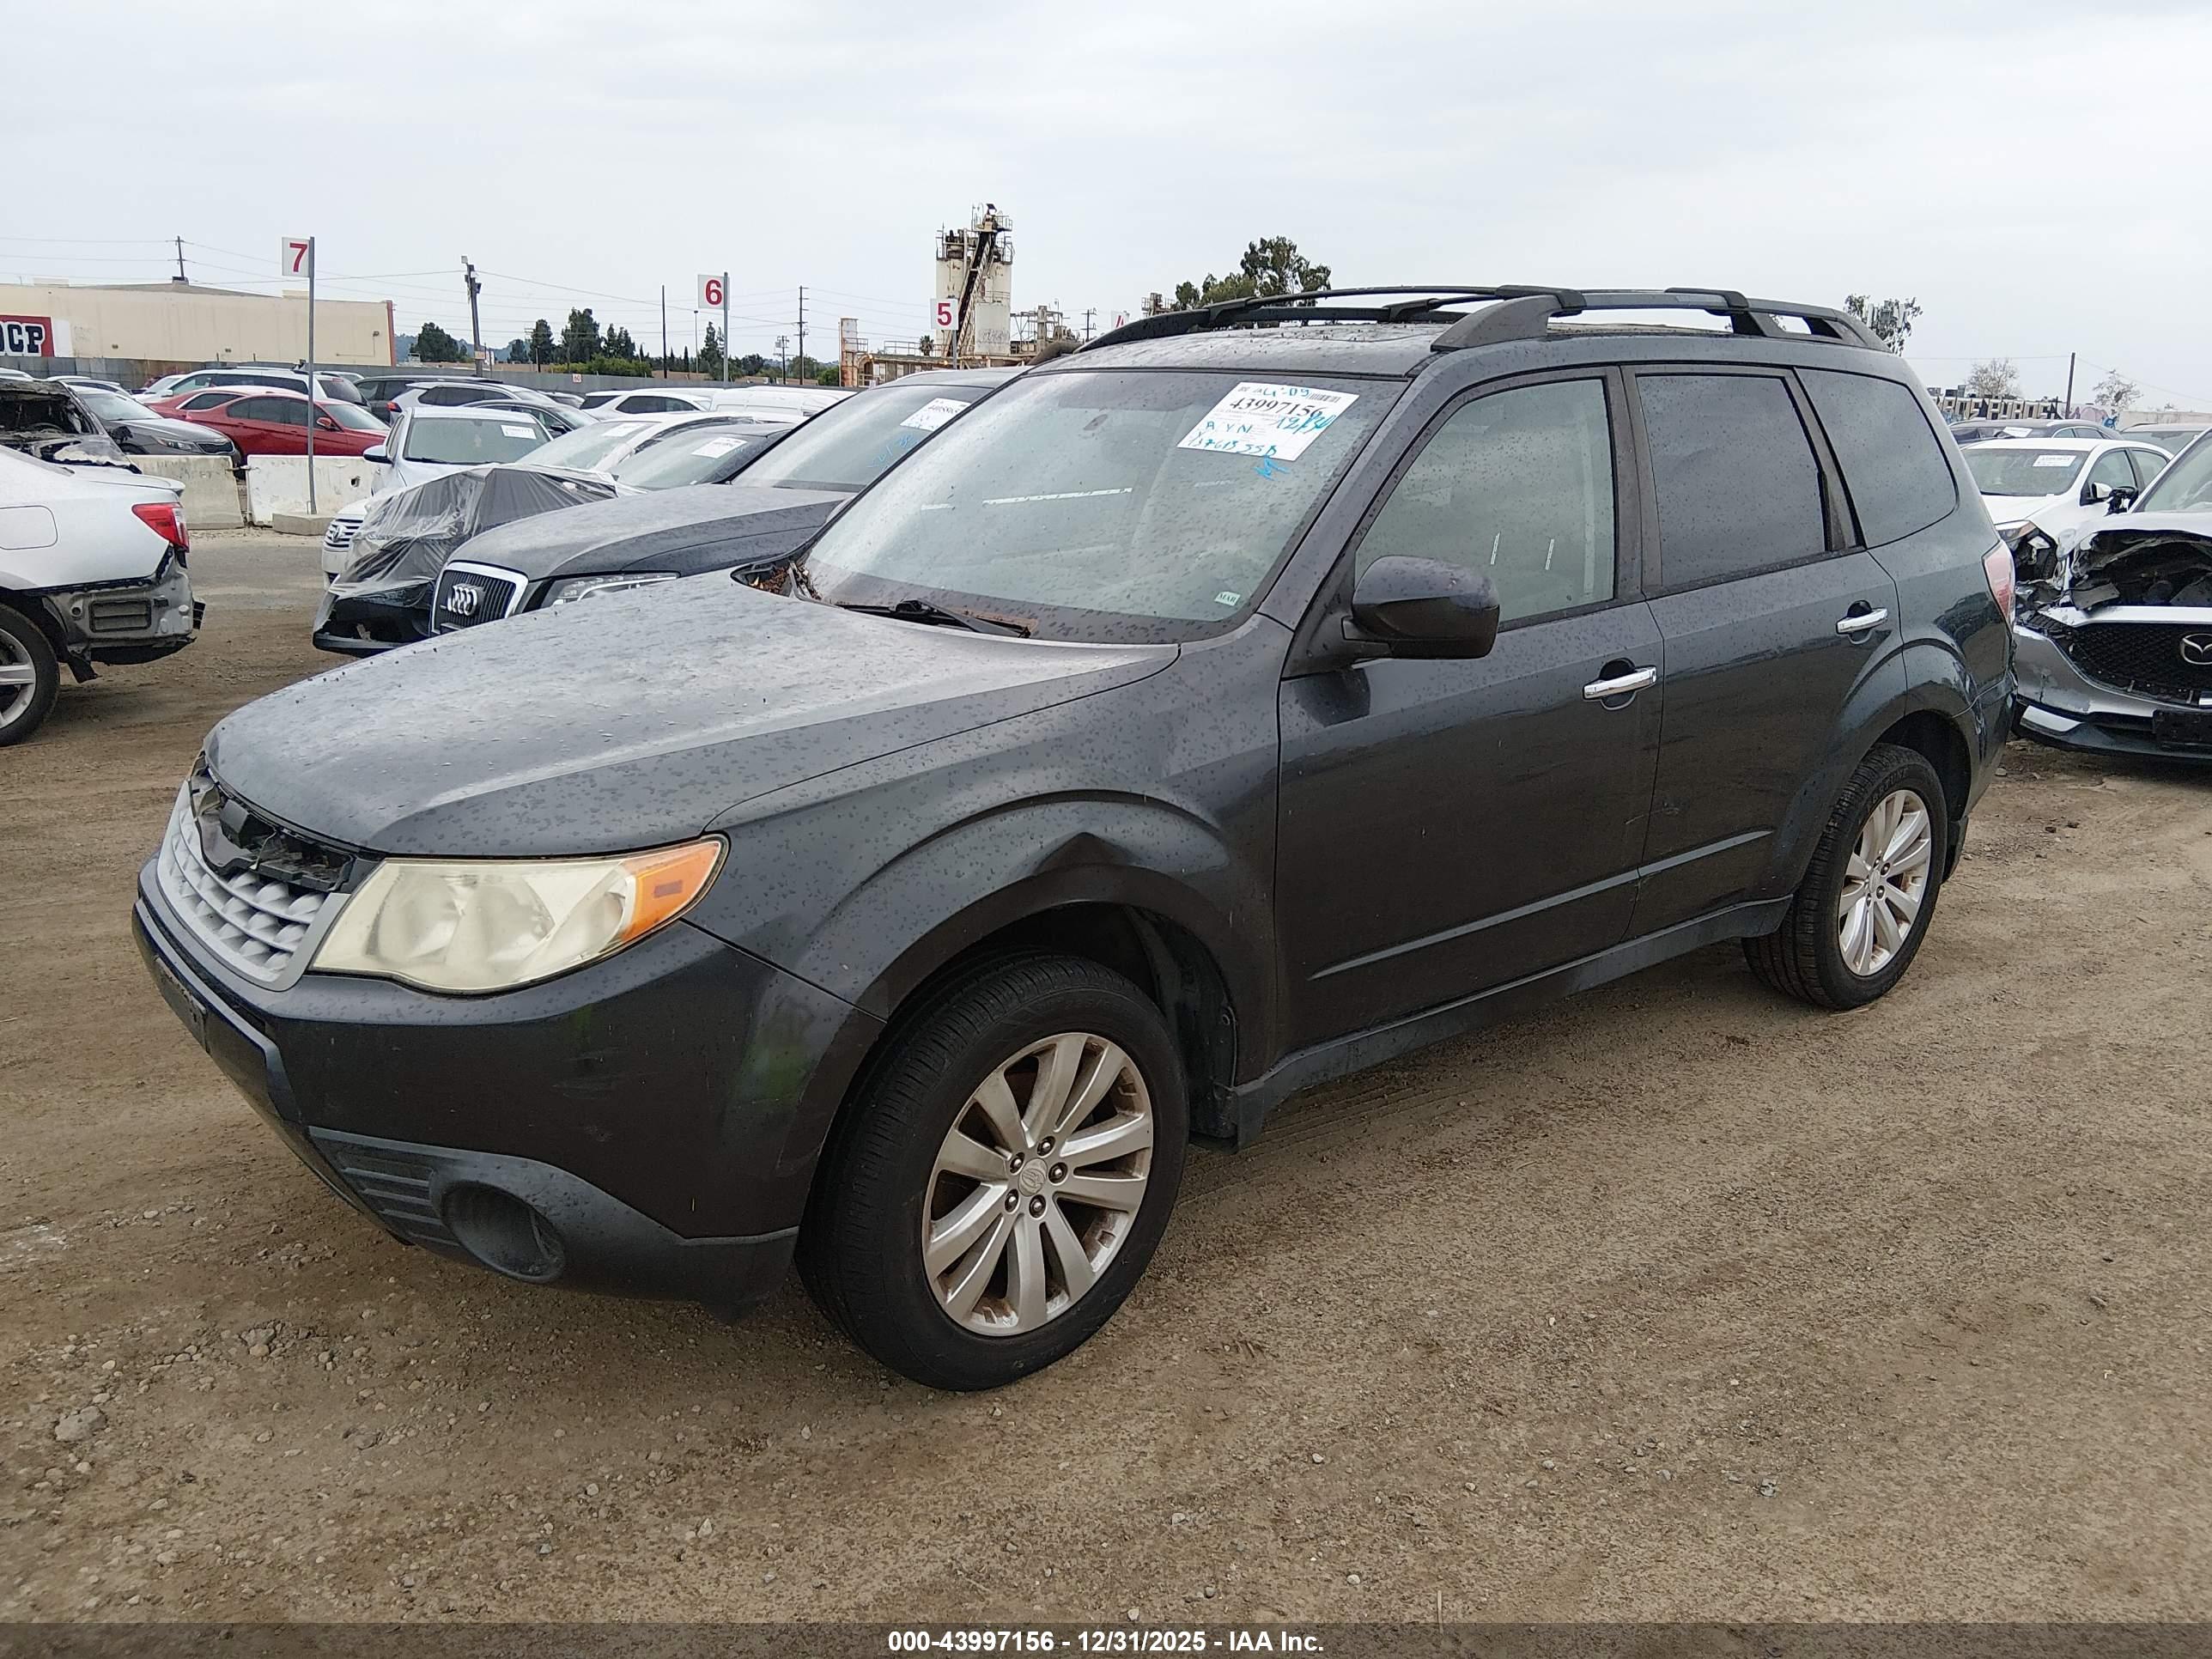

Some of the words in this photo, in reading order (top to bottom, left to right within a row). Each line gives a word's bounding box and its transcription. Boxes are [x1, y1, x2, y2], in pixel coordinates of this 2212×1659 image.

[289, 242, 307, 272] 7
[705, 279, 723, 306] 6
[937, 302, 952, 326] 5
[0, 321, 45, 356] CP
[1230, 398, 1327, 417] 43997156
